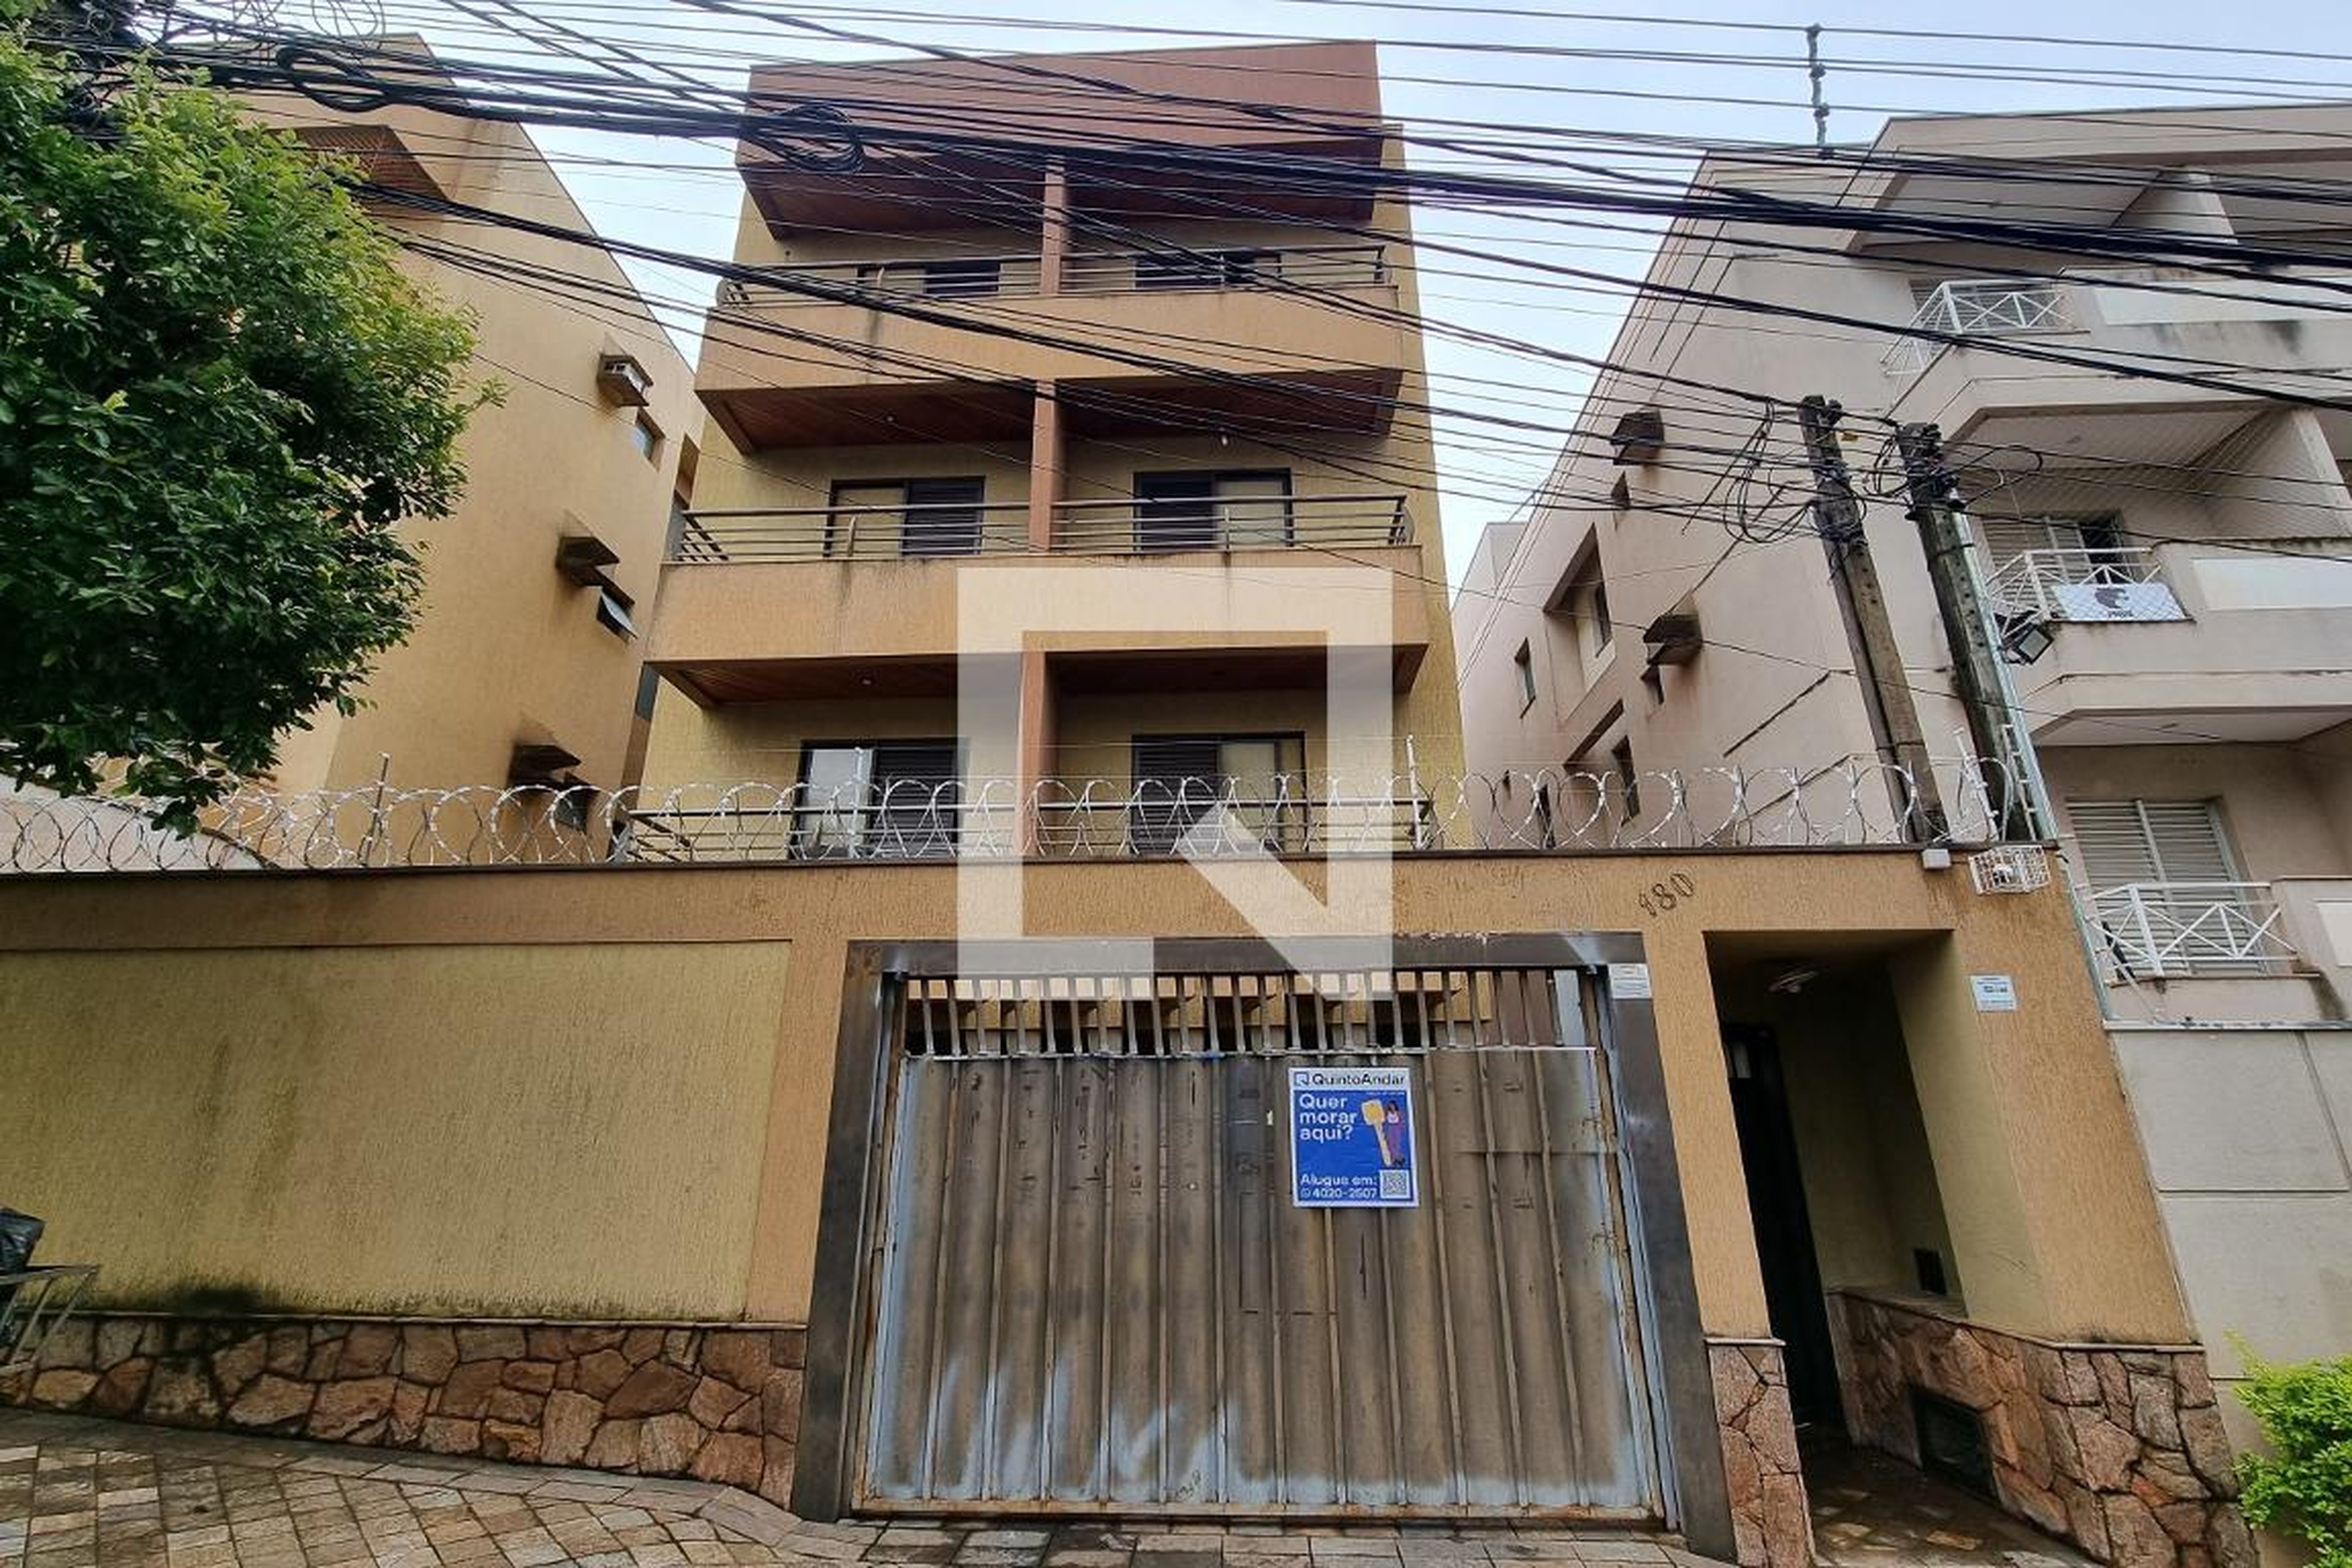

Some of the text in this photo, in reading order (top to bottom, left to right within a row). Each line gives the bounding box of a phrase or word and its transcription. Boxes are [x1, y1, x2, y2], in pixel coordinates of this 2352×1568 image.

[1638, 873, 1694, 918] 180
[1312, 1072, 1404, 1085] QuintoAndar
[1298, 1093, 1348, 1109] Quer
[1299, 1111, 1357, 1125] morar
[1299, 1125, 1353, 1144] aqui?
[1351, 1176, 1378, 1186] em:
